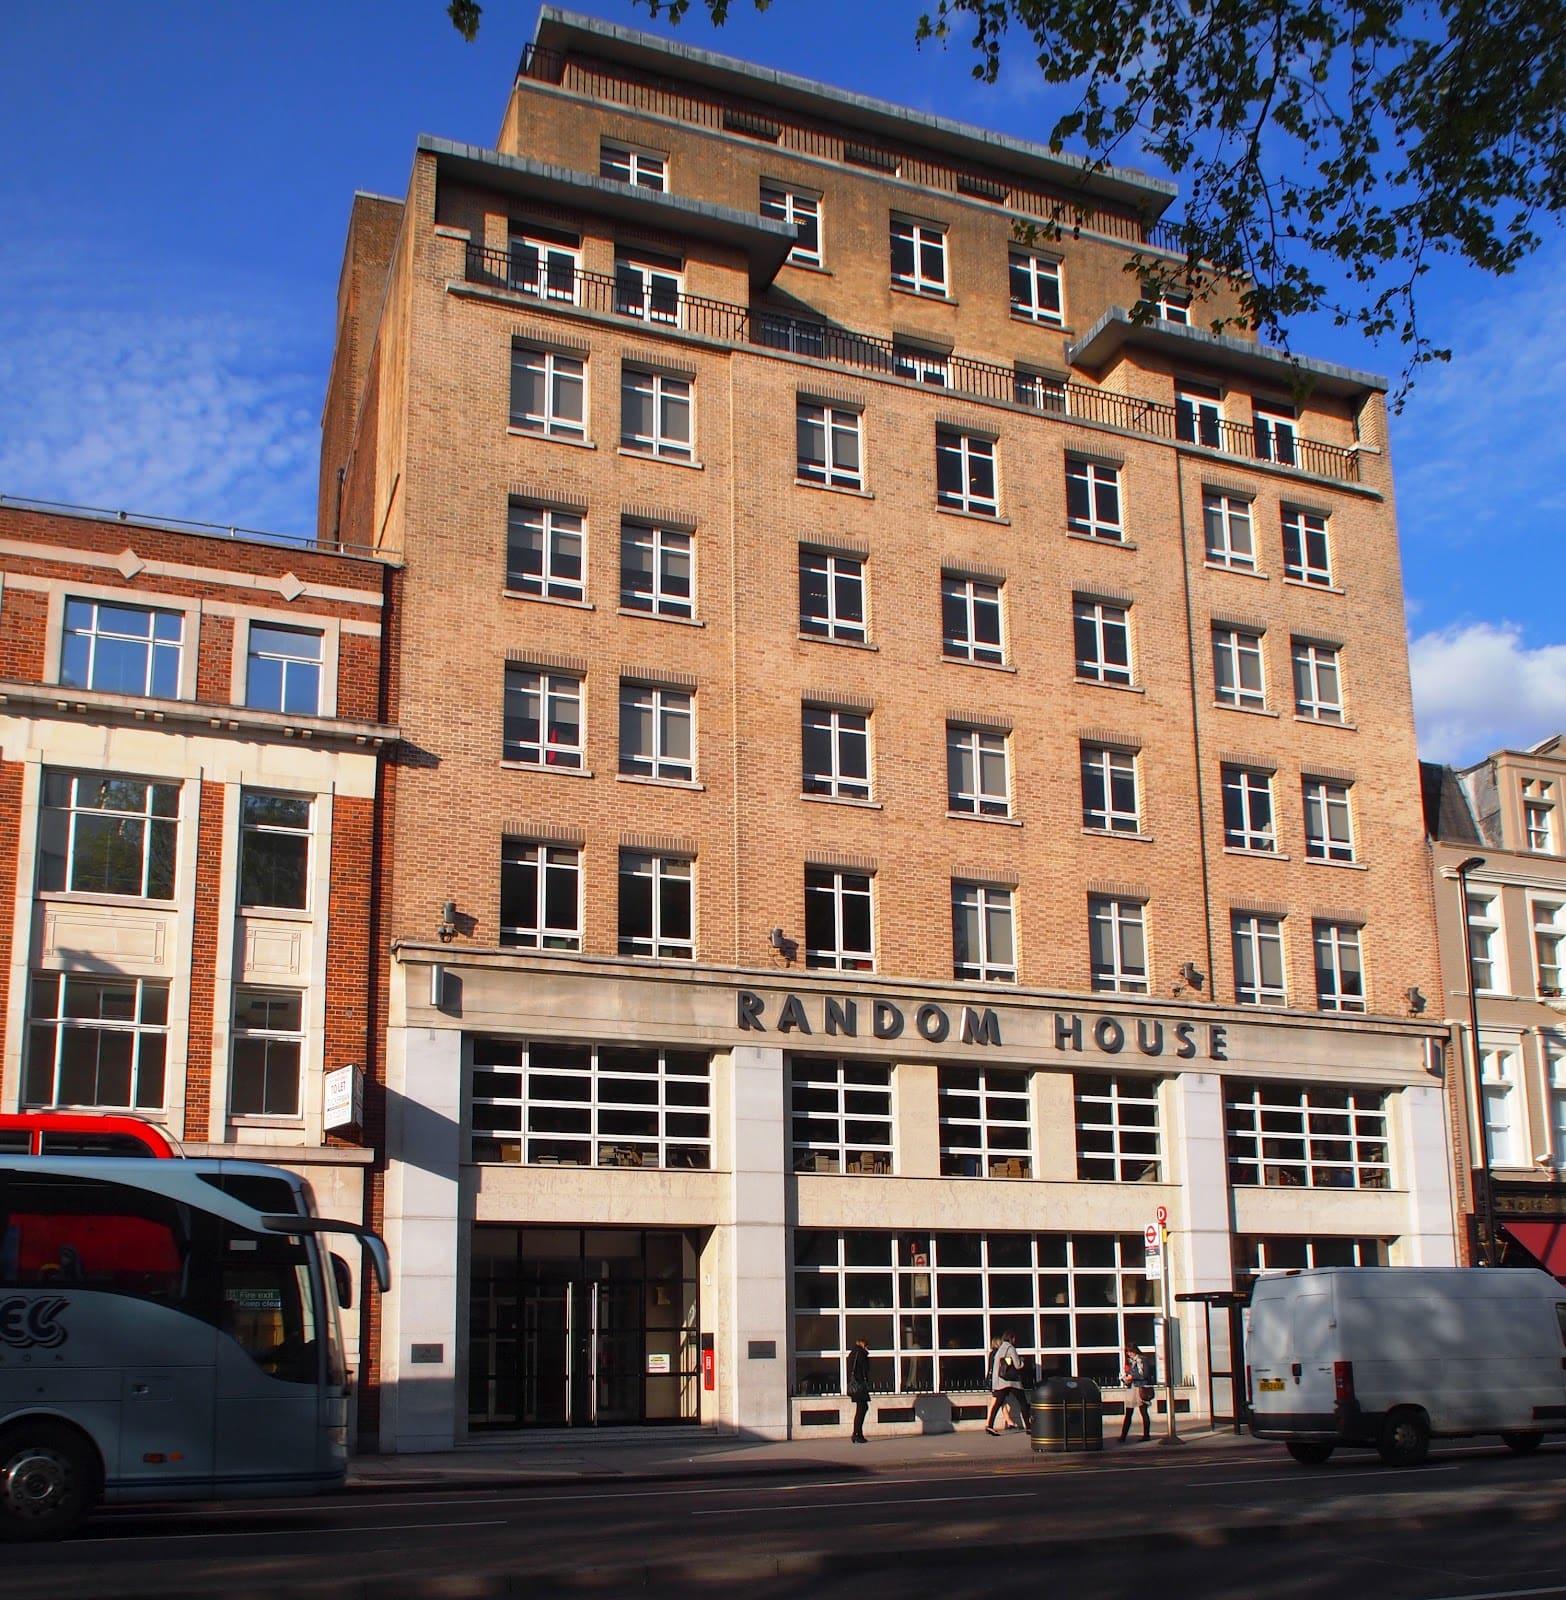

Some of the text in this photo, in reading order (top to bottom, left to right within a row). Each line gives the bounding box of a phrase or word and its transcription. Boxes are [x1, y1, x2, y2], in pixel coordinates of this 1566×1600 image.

[735, 989, 1228, 1061] RANDOM HOUSE
[1157, 1208, 1166, 1220] D
[240, 1291, 273, 1299] Fire exit
